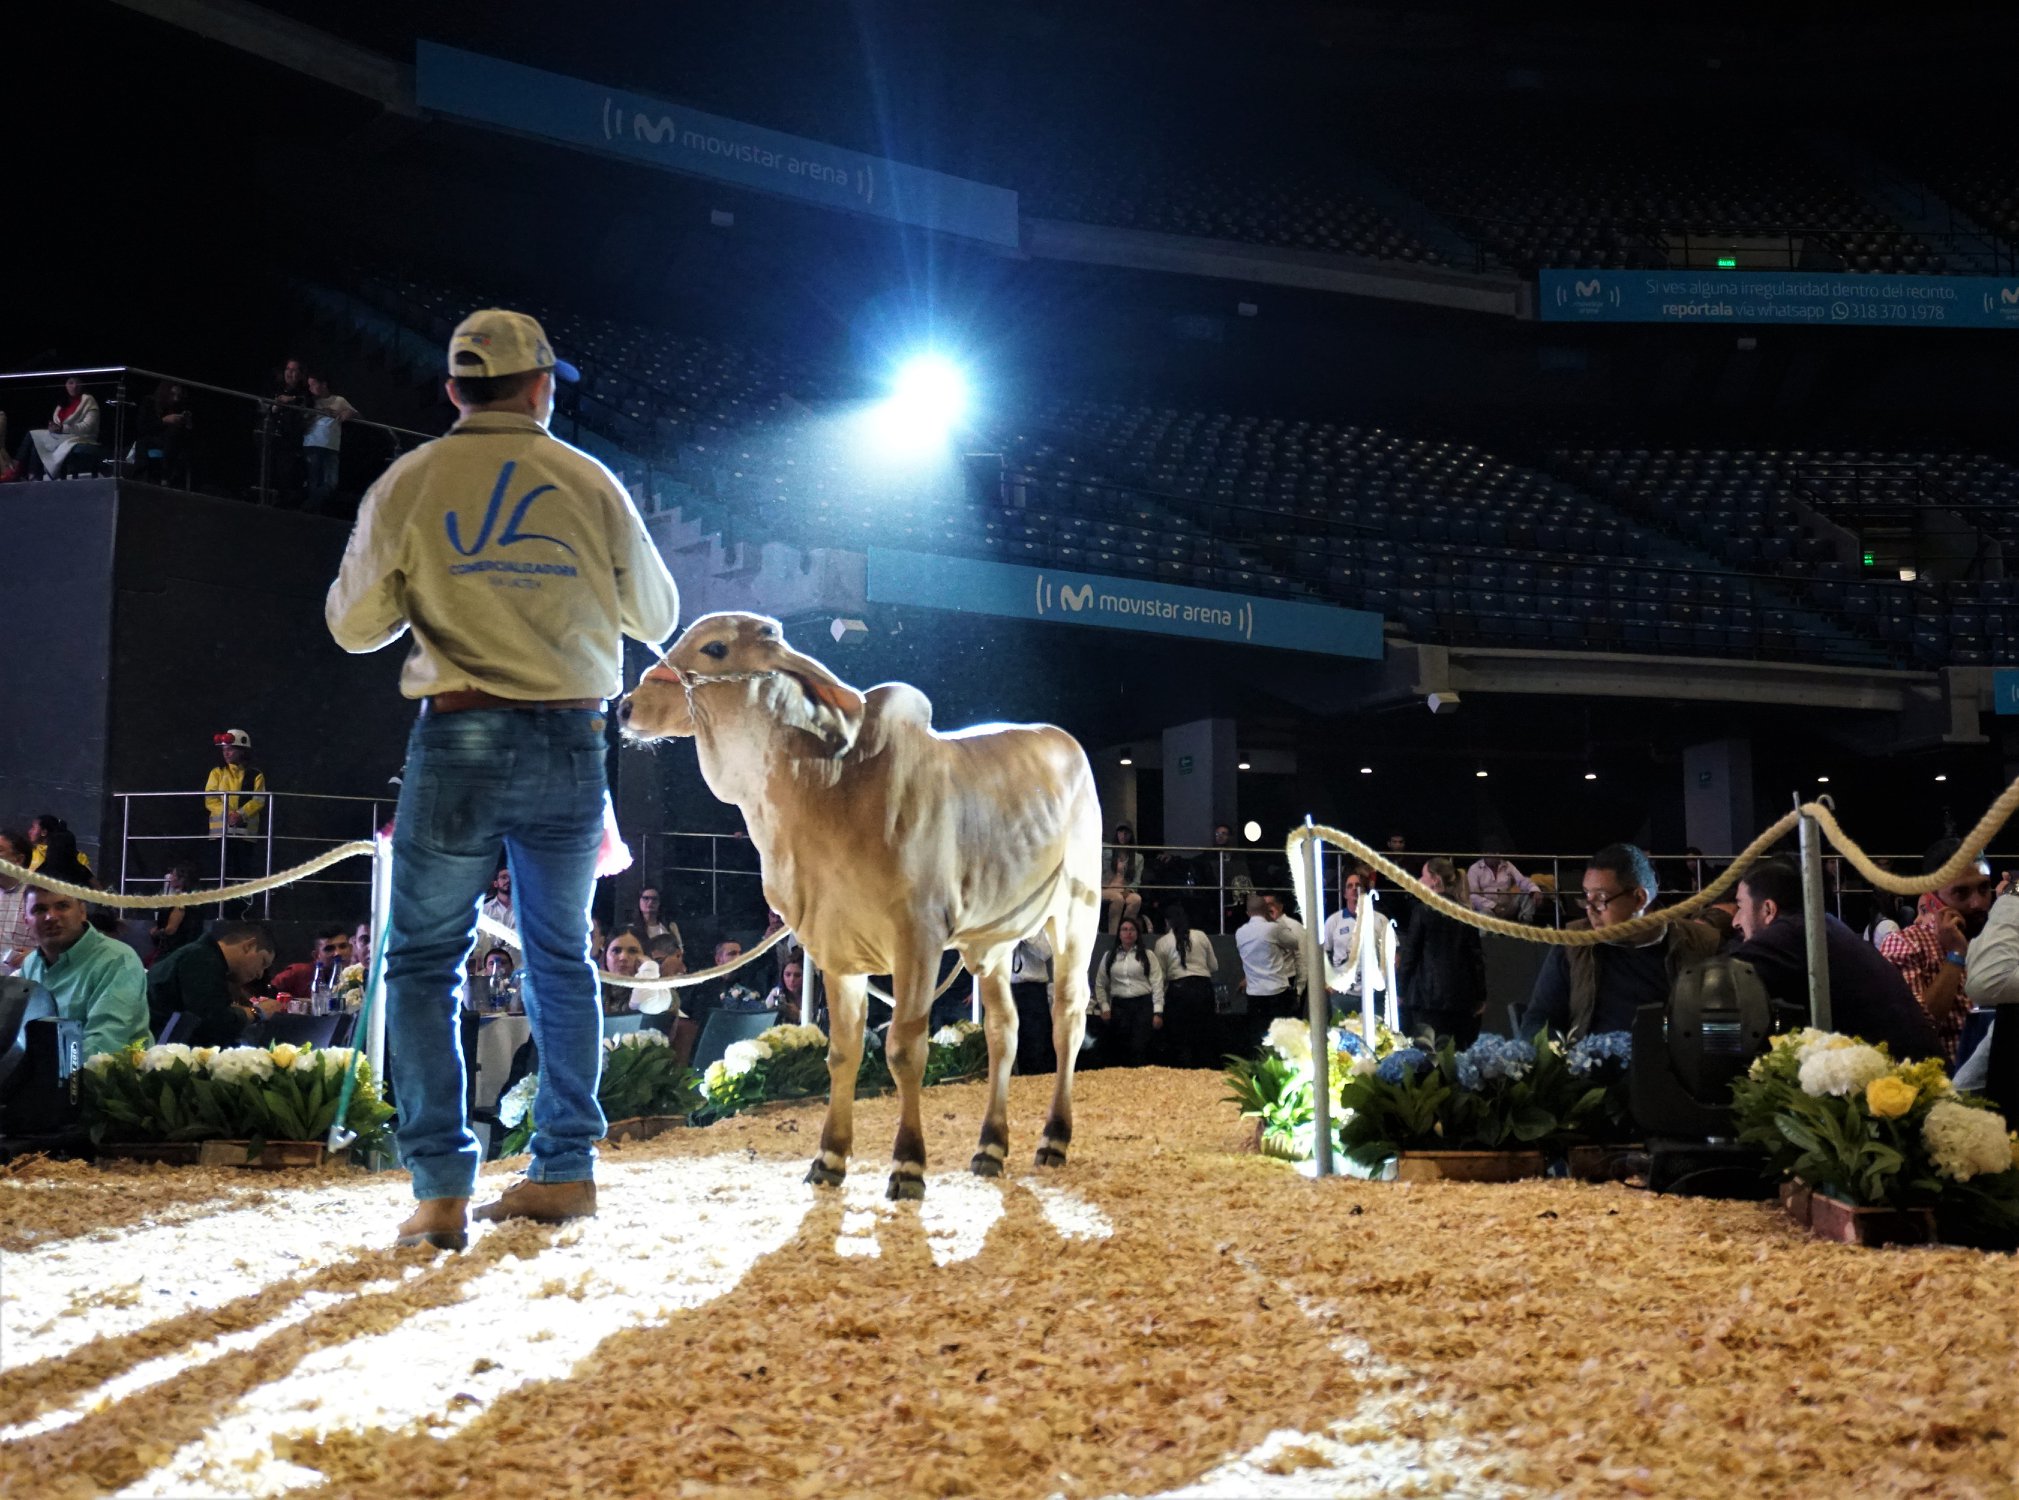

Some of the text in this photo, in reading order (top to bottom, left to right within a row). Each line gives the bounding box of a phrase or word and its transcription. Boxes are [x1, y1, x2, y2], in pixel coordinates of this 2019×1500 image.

[683, 130, 783, 168] movistar
[788, 157, 848, 186] arena
[1663, 282, 1686, 295] ves
[1689, 279, 1738, 298] alguna
[1741, 281, 1829, 299] irregularidad
[1833, 282, 1879, 298] dentro
[1883, 283, 1903, 298] del
[1663, 300, 1733, 318] repórtala
[1757, 302, 1825, 320] whatsapp
[1852, 303, 1878, 319] 318
[1880, 304, 1907, 319] 370
[1911, 304, 1945, 320] 1978
[1100, 594, 1179, 619] movistar
[1183, 605, 1232, 626] arena
